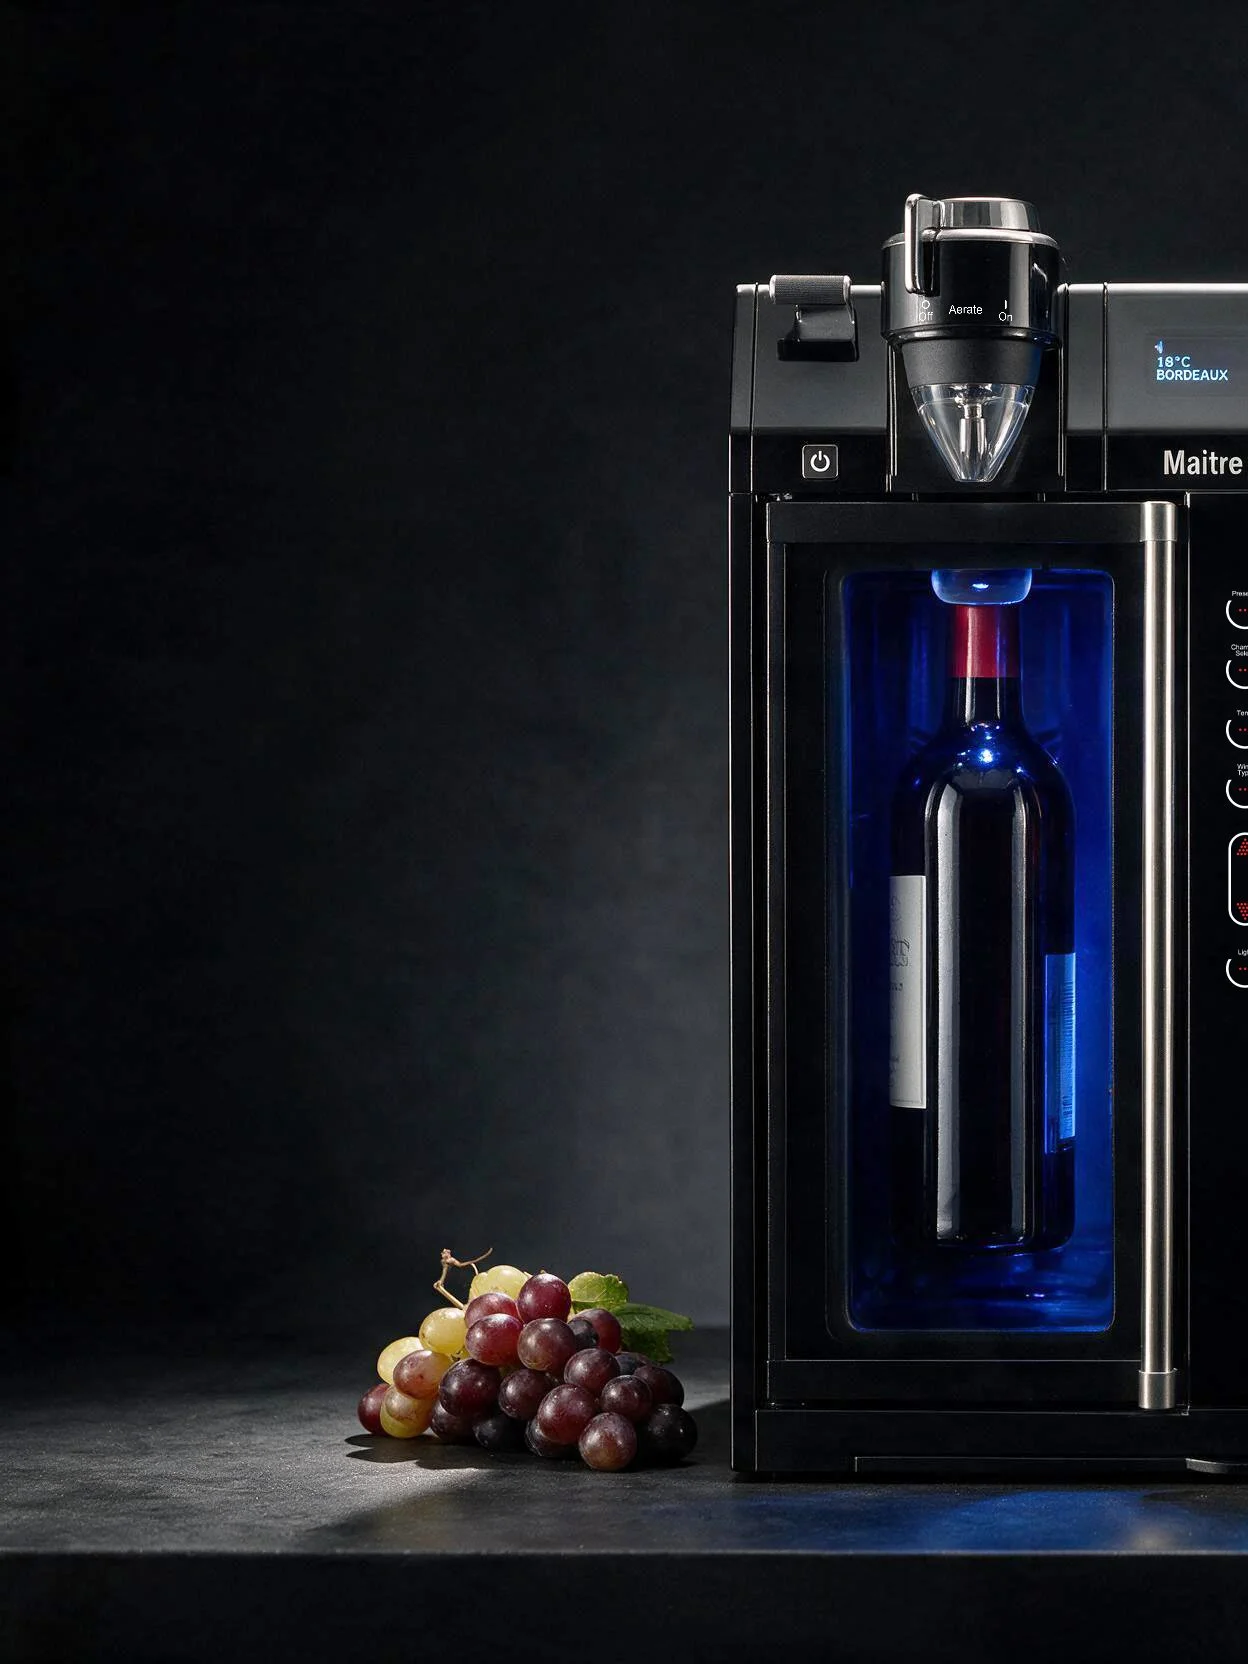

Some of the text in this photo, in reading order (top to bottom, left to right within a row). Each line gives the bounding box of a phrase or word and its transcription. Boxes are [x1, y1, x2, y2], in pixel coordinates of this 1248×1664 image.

[948, 304, 983, 315] Aerate
[918, 311, 933, 322] Off
[998, 311, 1013, 322] On
[1156, 369, 1229, 381] BORDEAUX
[1163, 449, 1244, 475] Maitre
